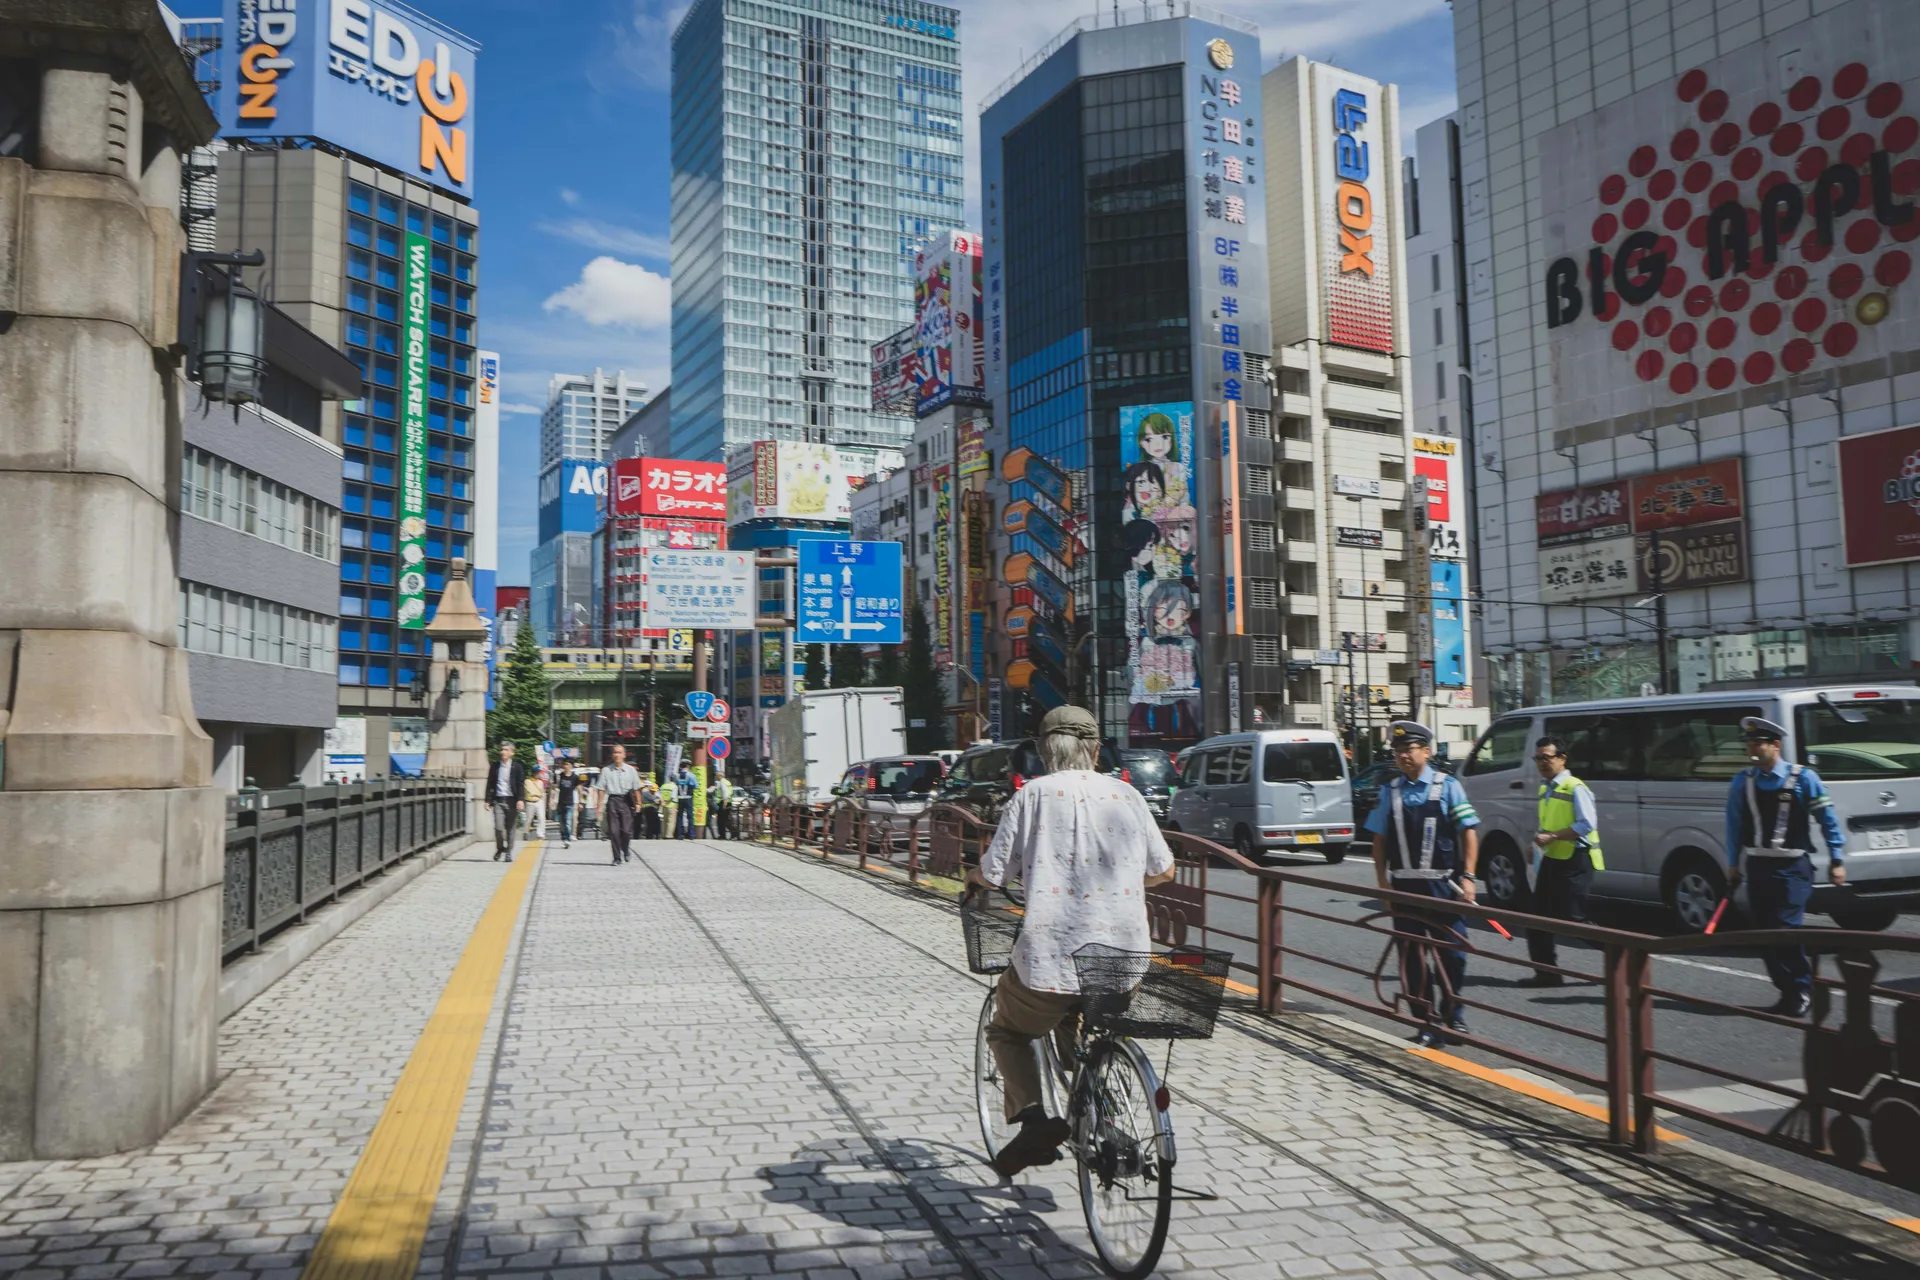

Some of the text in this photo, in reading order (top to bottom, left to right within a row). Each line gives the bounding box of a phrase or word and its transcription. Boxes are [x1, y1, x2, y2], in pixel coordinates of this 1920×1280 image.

[330, 0, 468, 183] EDION
[1220, 79, 1246, 225] 半田産業
[1214, 237, 1240, 257] 8F
[410, 244, 425, 325] WATCH
[1546, 231, 1668, 329] BIG
[407, 325, 424, 418] SQUARE
[831, 543, 863, 555] 上野
[667, 554, 726, 567] 国土交通省
[1686, 559, 1740, 579] MARU
[656, 584, 746, 596] 東京国道事務所
[666, 596, 736, 608] 万世橋出張所
[695, 698, 707, 709] 17
